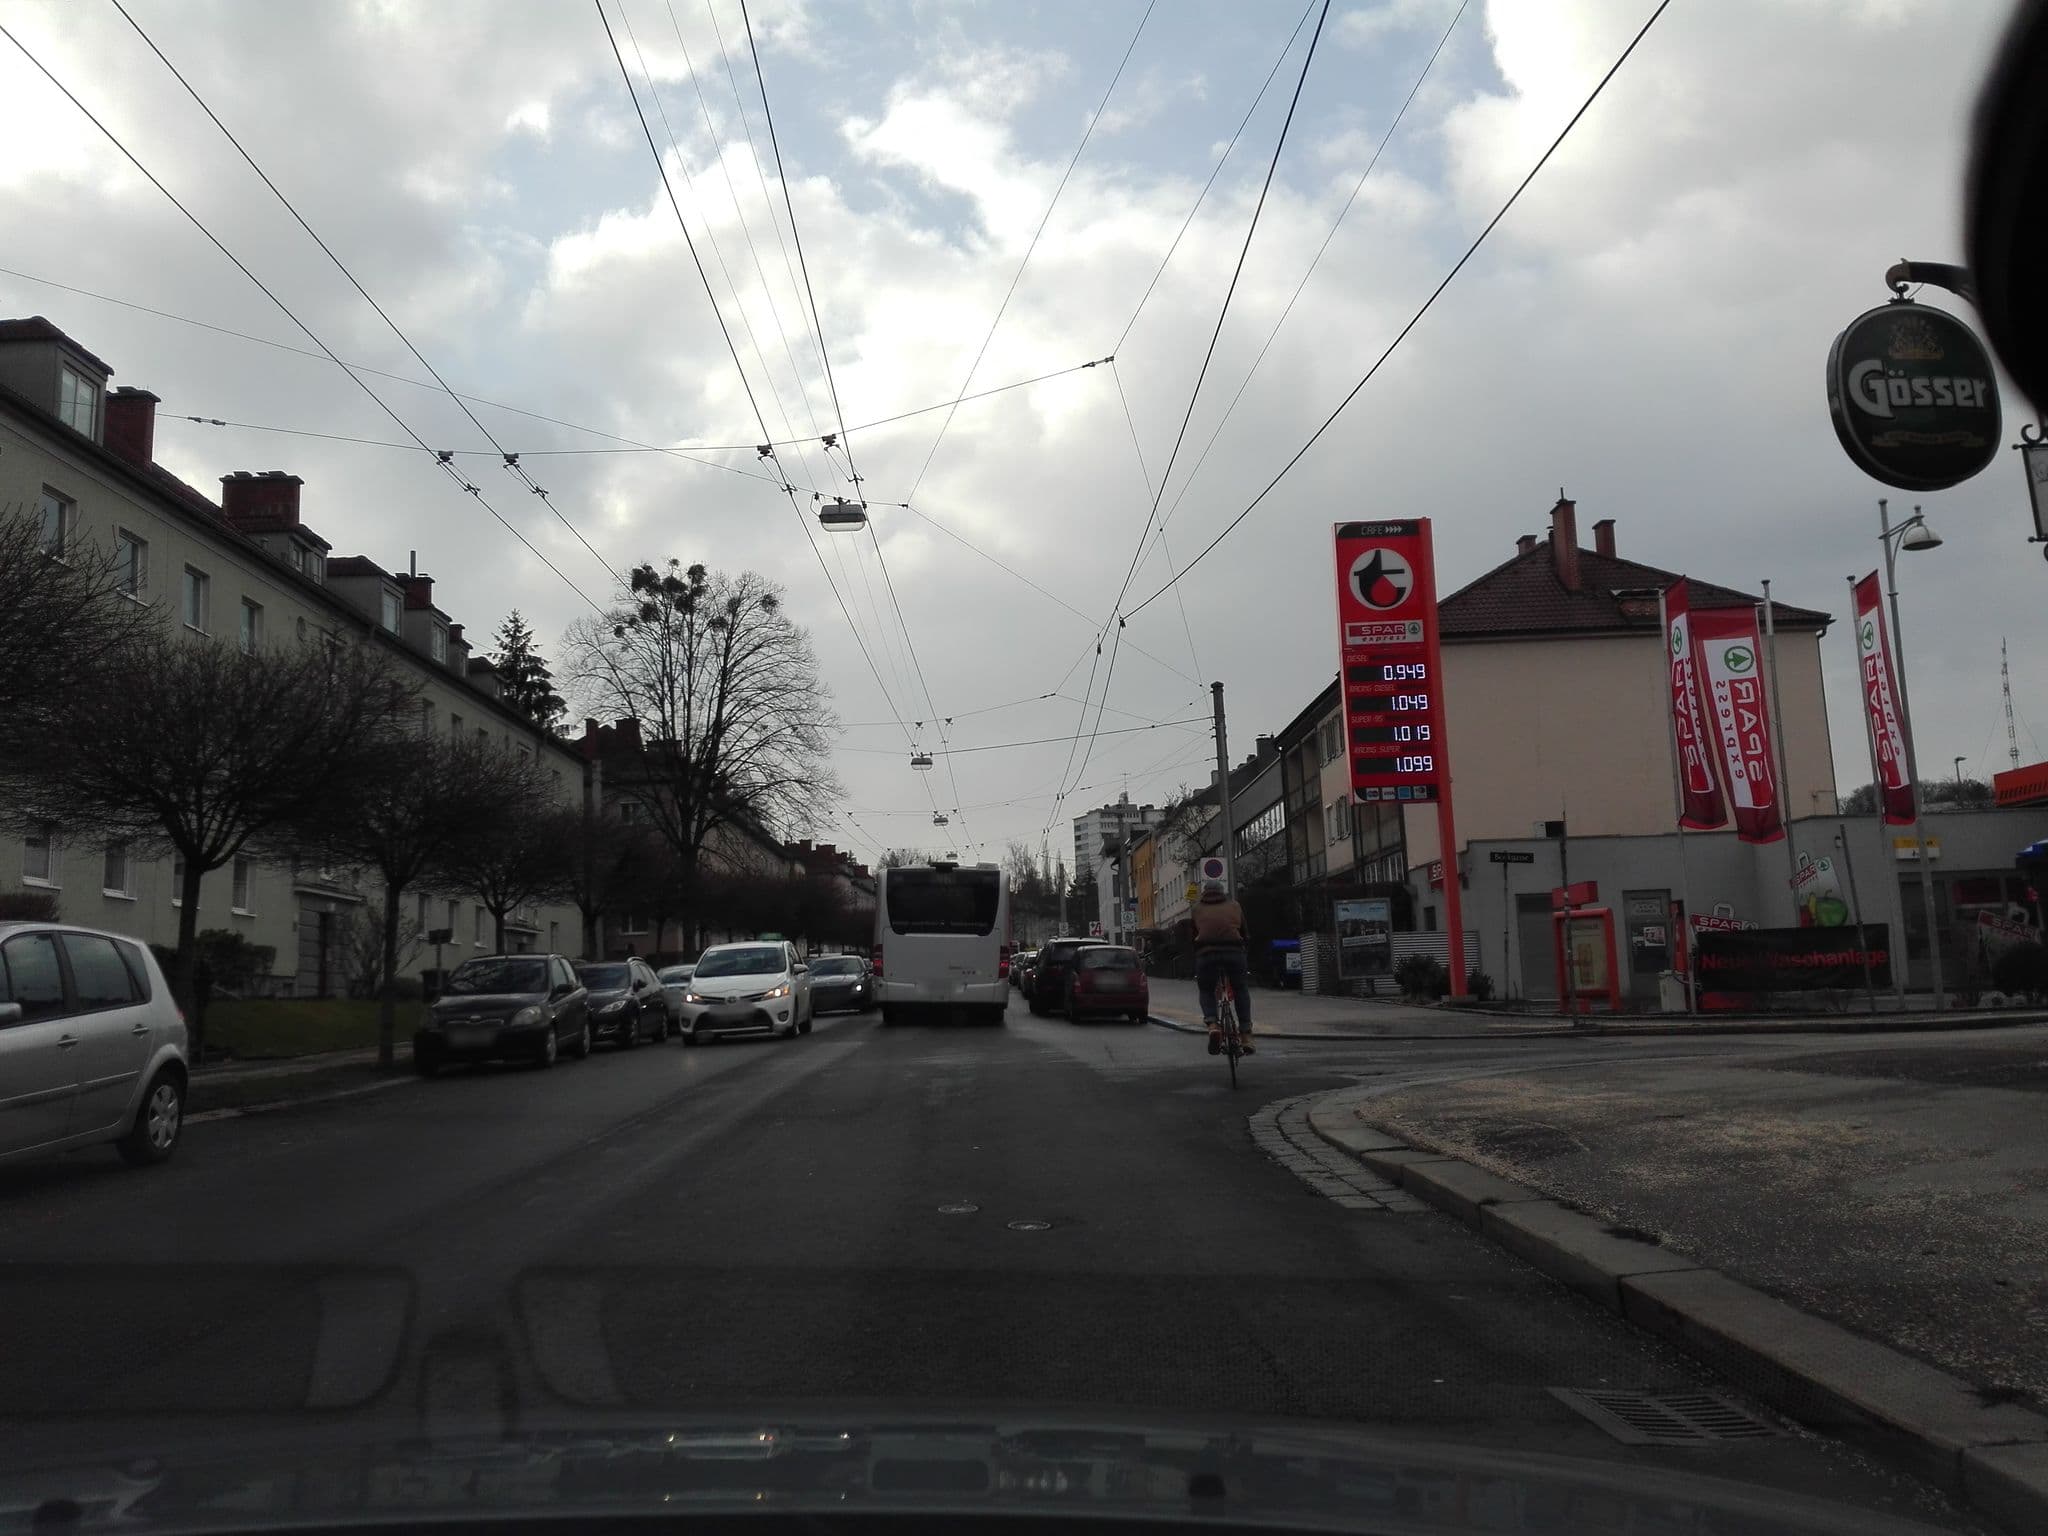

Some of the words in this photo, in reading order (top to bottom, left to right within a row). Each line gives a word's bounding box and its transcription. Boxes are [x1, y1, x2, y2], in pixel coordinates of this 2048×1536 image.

[1848, 360, 1987, 419] Gösser
[1361, 625, 1405, 635] SPAR
[1362, 635, 1406, 643] express
[1346, 655, 1368, 663] DIESEL
[1383, 664, 1426, 681] 0.949
[1391, 694, 1428, 711] 1.049
[1866, 658, 1893, 763] SPAR
[1394, 725, 1431, 741] 1.019
[1396, 755, 1433, 772] 1.099
[1796, 865, 1817, 885] SPAR
[1699, 916, 1743, 931] SPAR
[1991, 917, 2035, 939] SPAR
